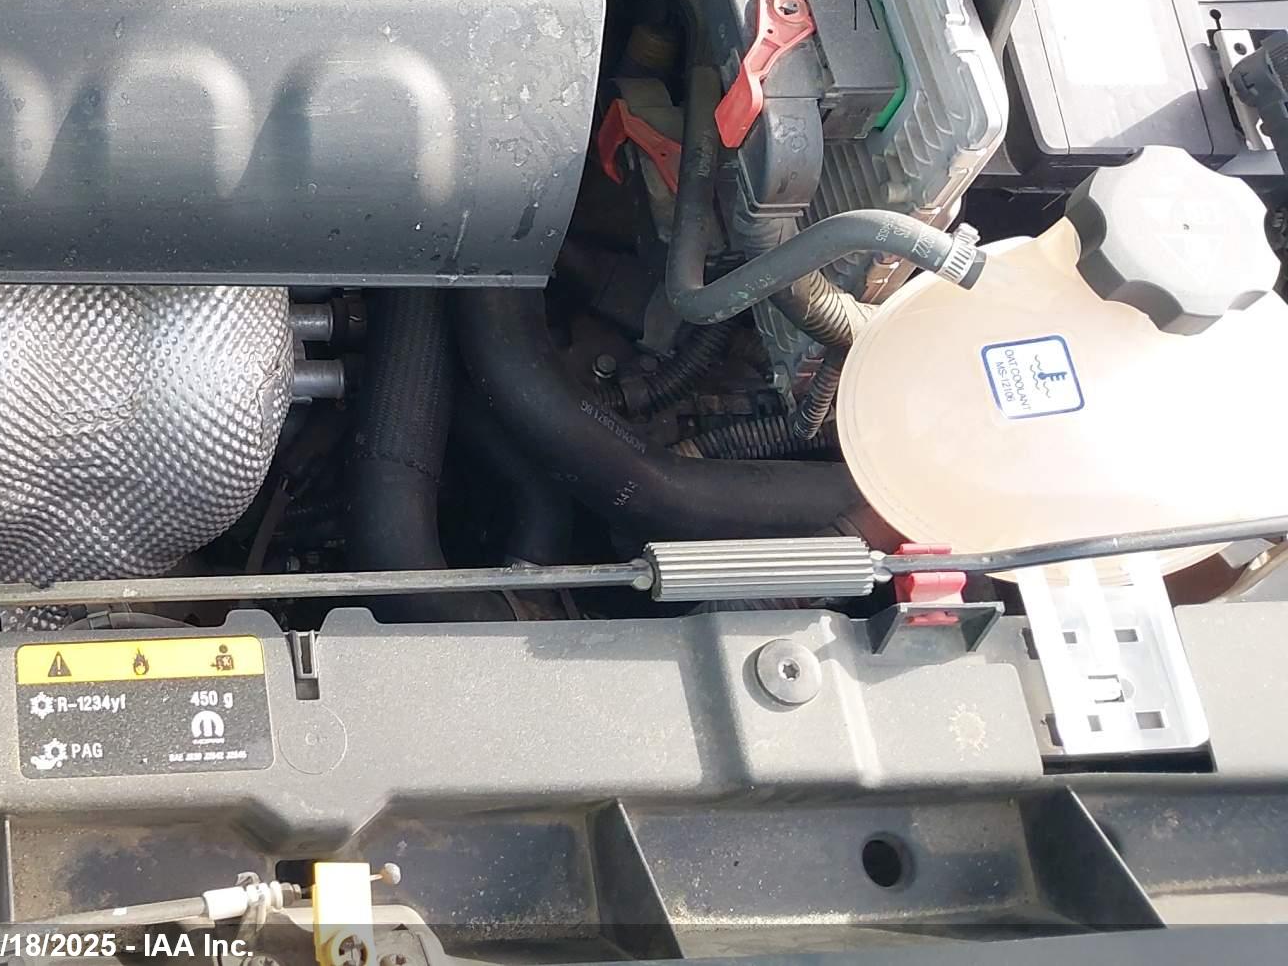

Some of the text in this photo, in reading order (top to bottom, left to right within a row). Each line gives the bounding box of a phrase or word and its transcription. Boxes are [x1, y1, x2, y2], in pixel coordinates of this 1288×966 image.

[1010, 368, 1032, 410] COOLANT
[57, 694, 126, 714] R-1234yf
[190, 690, 234, 709] 450 g
[71, 743, 103, 759] PAG
